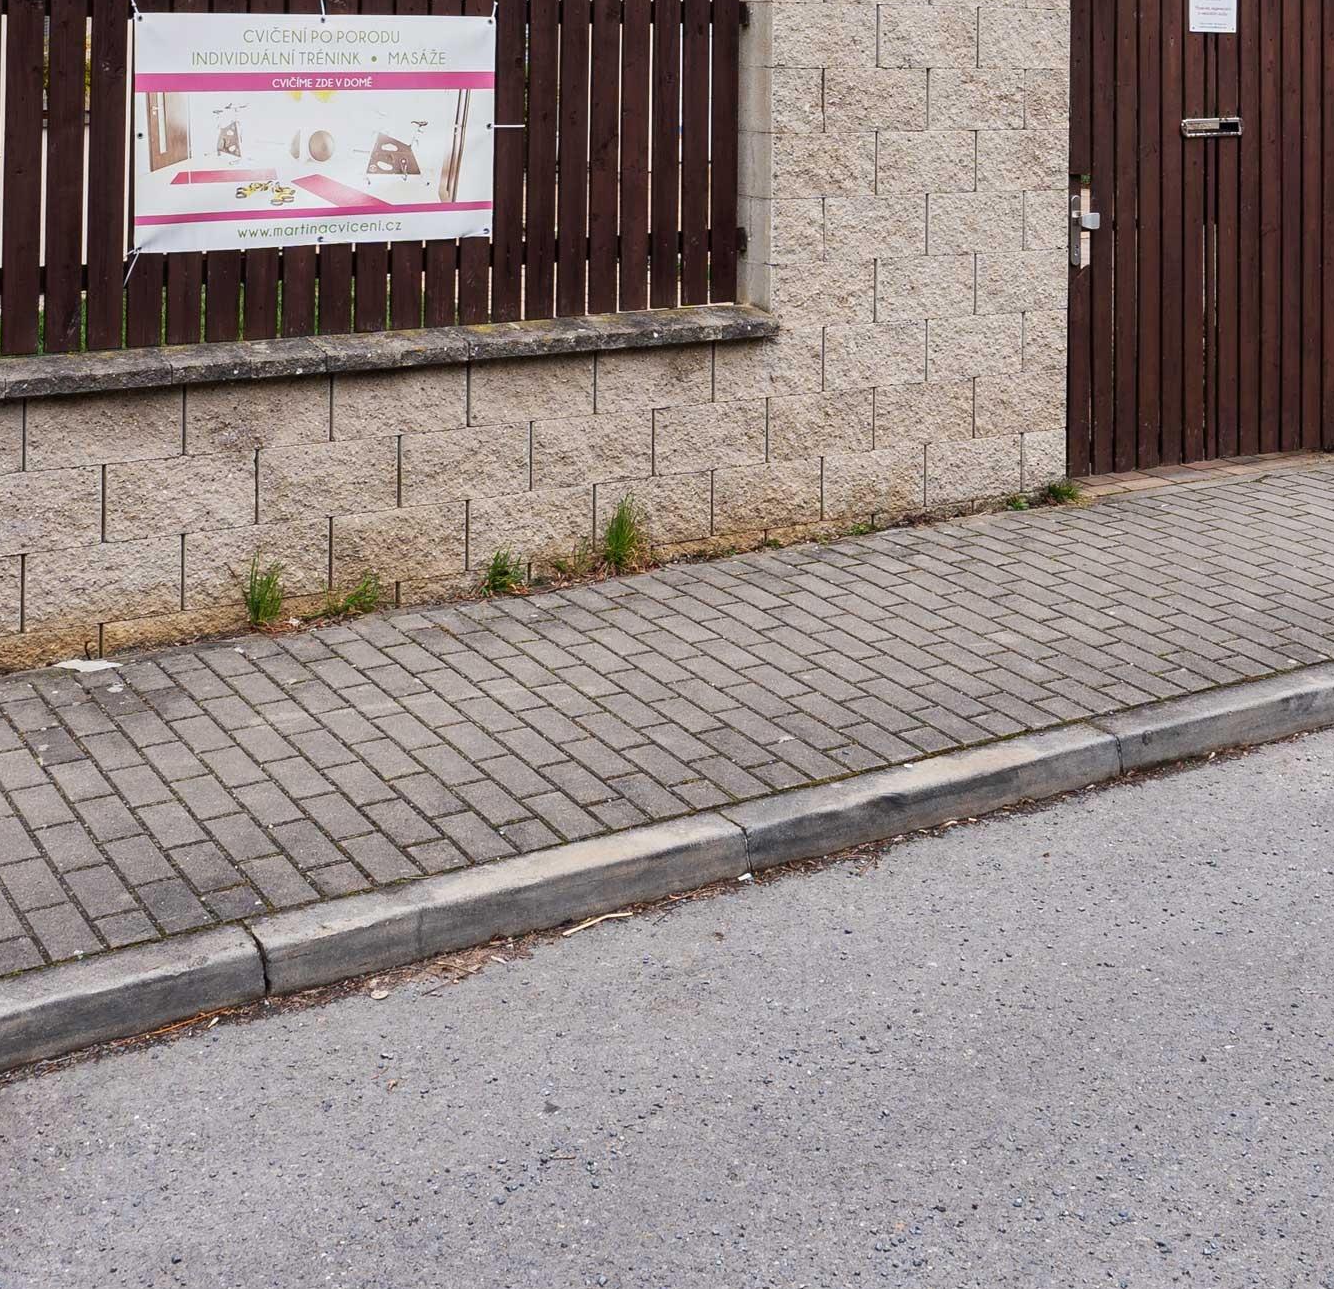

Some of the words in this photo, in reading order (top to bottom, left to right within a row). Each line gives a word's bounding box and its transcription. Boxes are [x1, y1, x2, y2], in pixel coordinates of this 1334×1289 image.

[243, 27, 306, 44] CVIČENÍ
[311, 30, 333, 44] PO
[336, 30, 400, 44] PORODU
[192, 49, 295, 66] INDIVIDUÁLNÍ
[298, 49, 361, 66] TRÉNINK
[387, 49, 446, 66] MASÁŽE
[272, 76, 313, 88] CVIČÍME
[315, 78, 333, 88] ZDE
[335, 78, 342, 88] V
[237, 220, 402, 239] www.martinacviceni.cz
